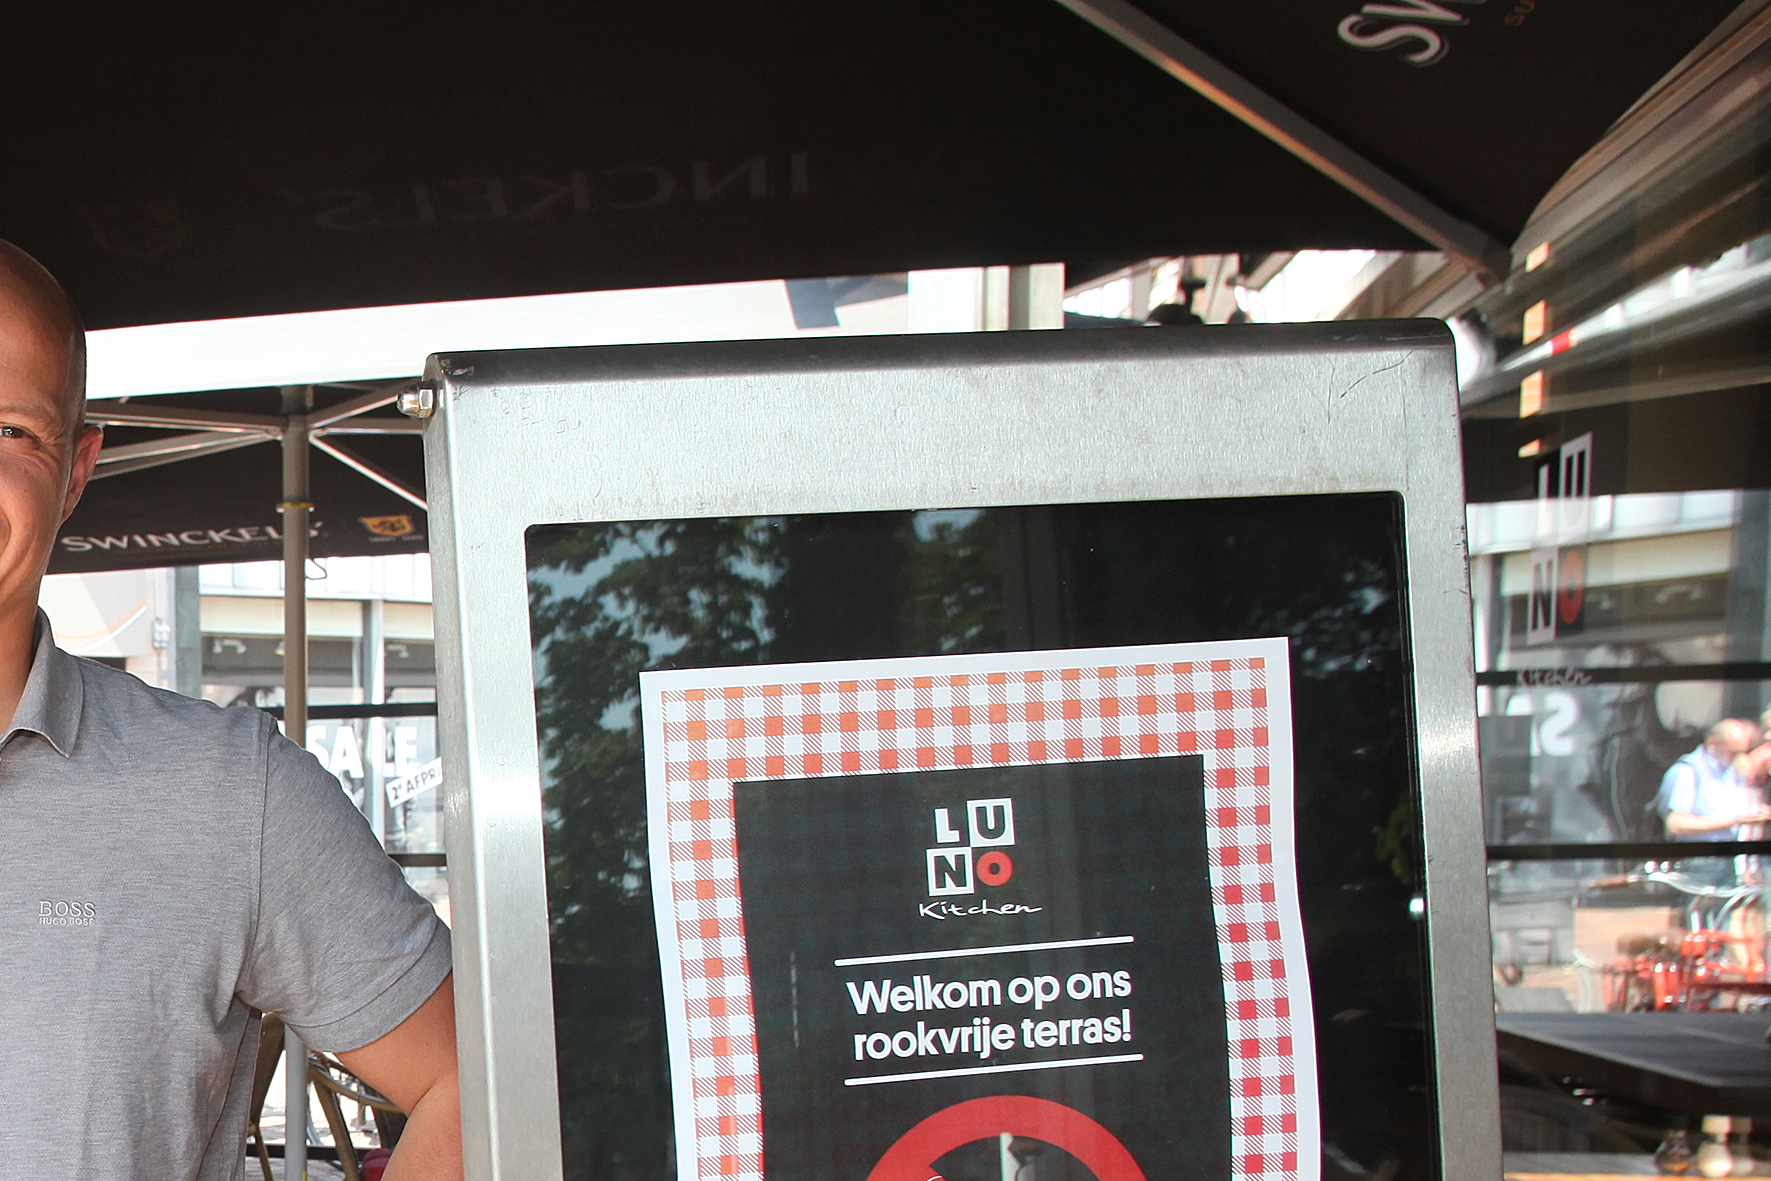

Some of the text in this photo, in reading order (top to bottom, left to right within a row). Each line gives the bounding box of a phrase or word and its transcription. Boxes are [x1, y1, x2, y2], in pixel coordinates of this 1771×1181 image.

[38, 900, 96, 918] BOSS
[918, 899, 1043, 920] Kitchen
[39, 917, 96, 927] HUGO BOSS
[845, 969, 1133, 1016] Welkom op ons
[853, 1008, 1133, 1062] rookvrije terras!
